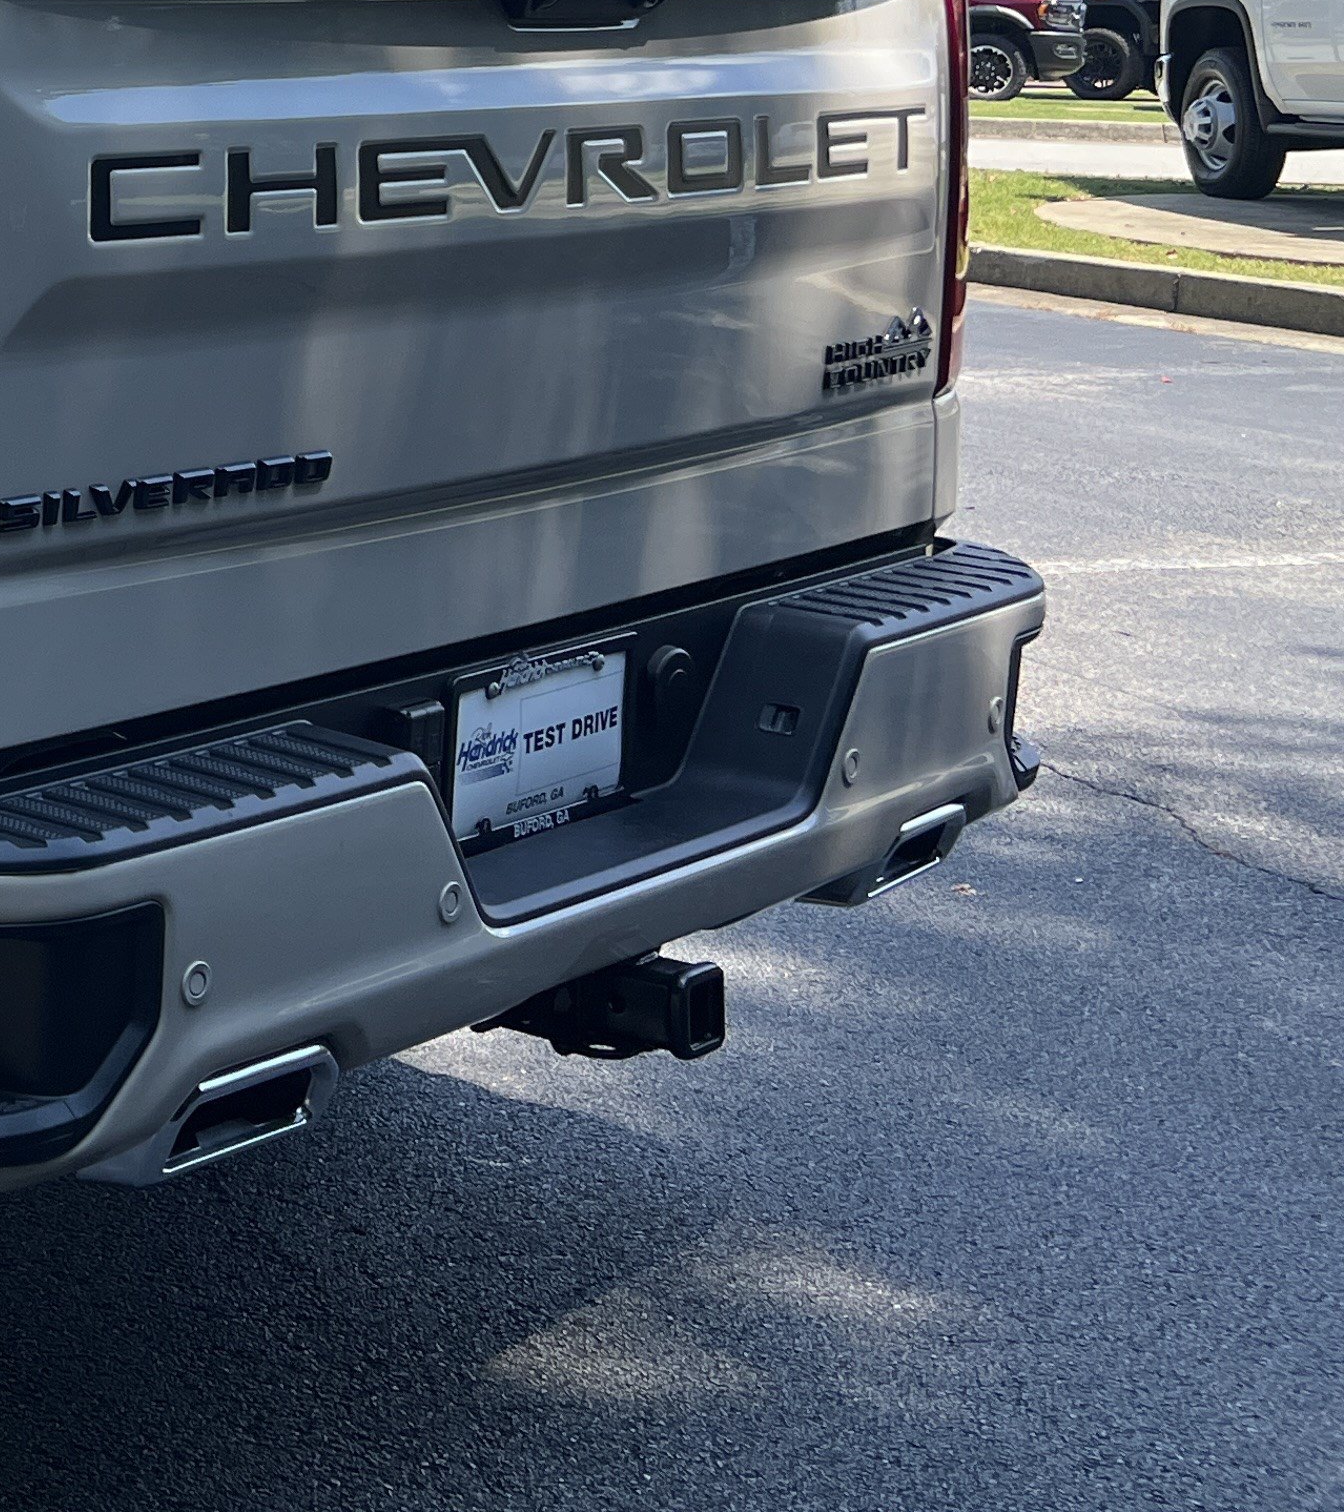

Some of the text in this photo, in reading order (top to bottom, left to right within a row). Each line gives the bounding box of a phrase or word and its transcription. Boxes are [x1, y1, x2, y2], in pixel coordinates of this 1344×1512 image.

[88, 105, 926, 244] CHEVROLET
[822, 348, 932, 390] COUNTRY
[824, 335, 883, 365] HIGH
[456, 728, 518, 772] Hendrick
[523, 706, 618, 754] TEST DRIVE
[556, 810, 570, 824] GA
